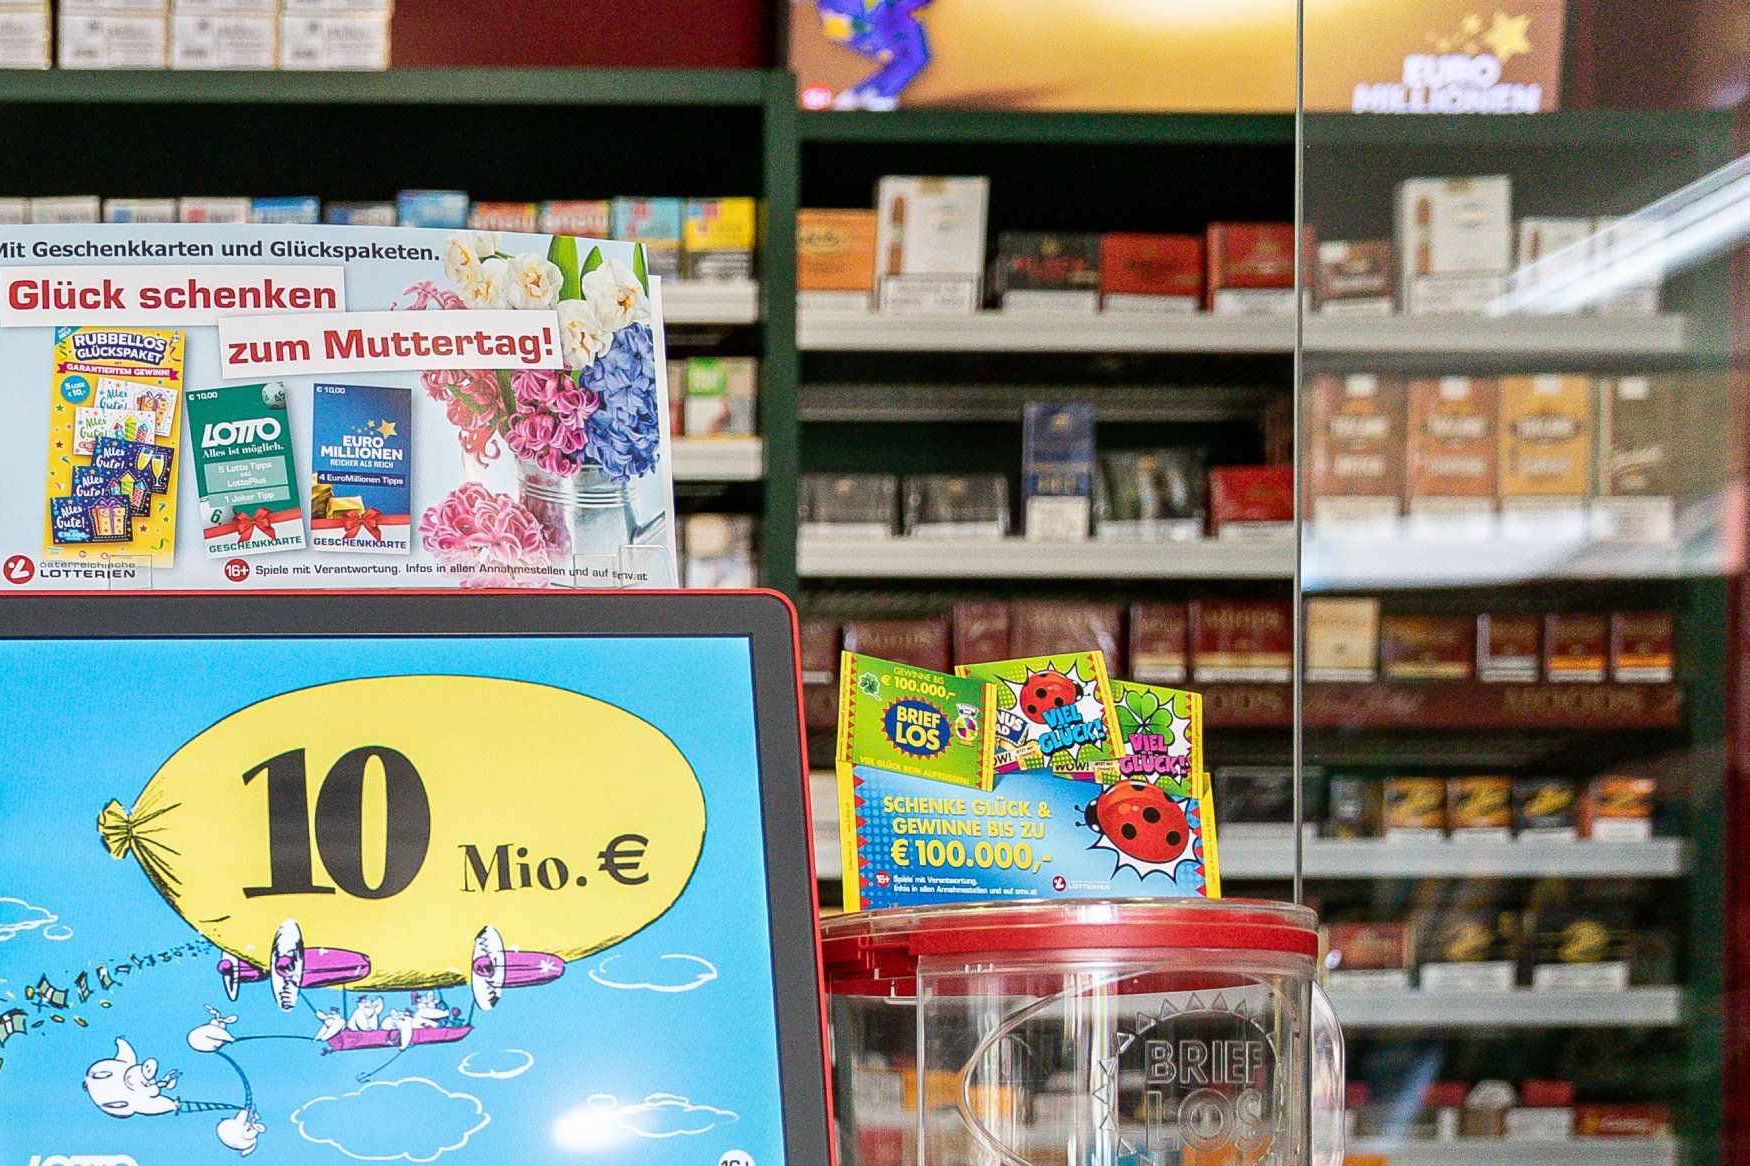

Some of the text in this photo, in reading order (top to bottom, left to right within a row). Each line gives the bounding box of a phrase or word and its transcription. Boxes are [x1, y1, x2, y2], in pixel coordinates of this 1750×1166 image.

[33, 240, 214, 258] Geschenkkarten
[221, 241, 263, 257] und
[271, 240, 439, 261] Glückspaketen.
[9, 279, 336, 309] Glück schenken
[74, 333, 165, 352] RUBBELLOS
[228, 327, 552, 364] zum Muttertag!
[77, 345, 162, 363] GLÜCKSPAKET
[67, 363, 132, 375] GARANTIERTEM
[201, 418, 281, 447] LOTTO
[342, 435, 384, 448] EURO
[203, 442, 284, 458] Alles ist möglich.
[320, 446, 403, 461] MILLIONEN
[227, 462, 272, 472] Lotto Tipps
[330, 459, 394, 469] REICHER ALS REICH
[327, 473, 404, 486] EuroMillionen Tipps
[209, 535, 302, 554] GESCHENKKARTE
[313, 537, 406, 549] GESCHENKKARTE
[40, 570, 135, 578] LOTTERIEN
[226, 564, 249, 577] 16+
[256, 562, 609, 578] Spiele mit Verantwortung. Infos in allen Annahmestellen und auf
[894, 667, 945, 684] GEWINNE BIS
[881, 674, 955, 700] € 100.000,-
[897, 706, 941, 728] BRIEF
[1042, 704, 1082, 729] VIEL
[896, 723, 941, 750] LOS
[1038, 718, 1106, 756] GLÜCK!
[1129, 734, 1168, 755] VIEL
[1055, 762, 1090, 772] WOW!
[1120, 751, 1188, 776] GLÜCK!
[884, 796, 1051, 819] SCHENKE GLÜCK &
[242, 745, 431, 900] 10
[892, 818, 1045, 839] GEWINNE BIS ZU
[460, 833, 648, 894] Mio. €
[891, 839, 1052, 873] € 100.000,-
[894, 875, 913, 884] Spiele
[1145, 1040, 1263, 1084] BRIEF
[1146, 1088, 1263, 1151] LOS
